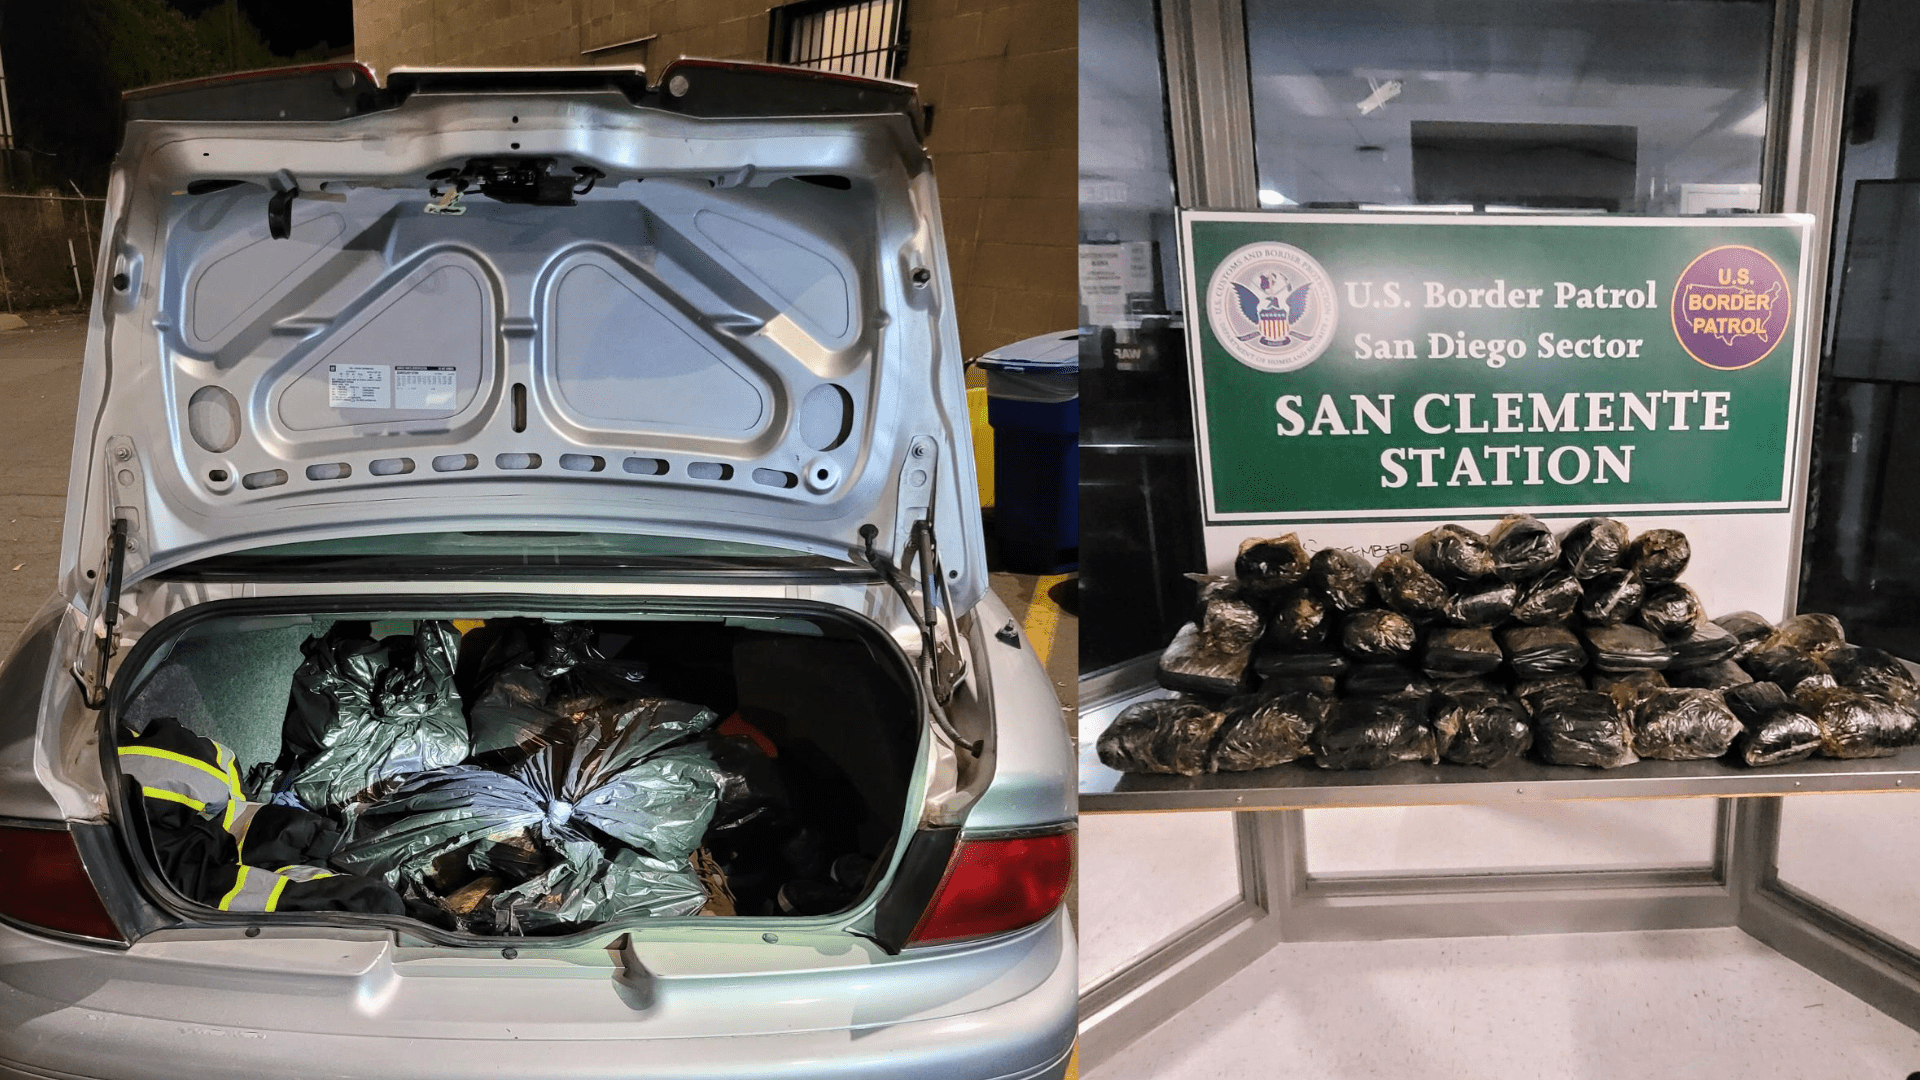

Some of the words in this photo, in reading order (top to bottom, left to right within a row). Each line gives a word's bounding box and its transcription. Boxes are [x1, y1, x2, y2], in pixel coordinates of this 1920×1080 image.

[1216, 258, 1243, 297] CUSTOMS
[1243, 250, 1263, 263] AND
[1264, 249, 1301, 265] BORDER
[1718, 268, 1754, 285] U.S.
[1344, 281, 1411, 309] U.S.
[1423, 279, 1544, 309] Border
[1554, 280, 1658, 309] Patrol
[1688, 294, 1770, 311] BORDER
[1693, 317, 1766, 334] PATROL
[1354, 332, 1418, 360] San
[1427, 330, 1527, 369] Diego
[1538, 332, 1644, 359] Sector
[1275, 394, 1396, 437] SAN
[1413, 390, 1731, 435] CLEMENTE
[1380, 444, 1636, 489] STATION
